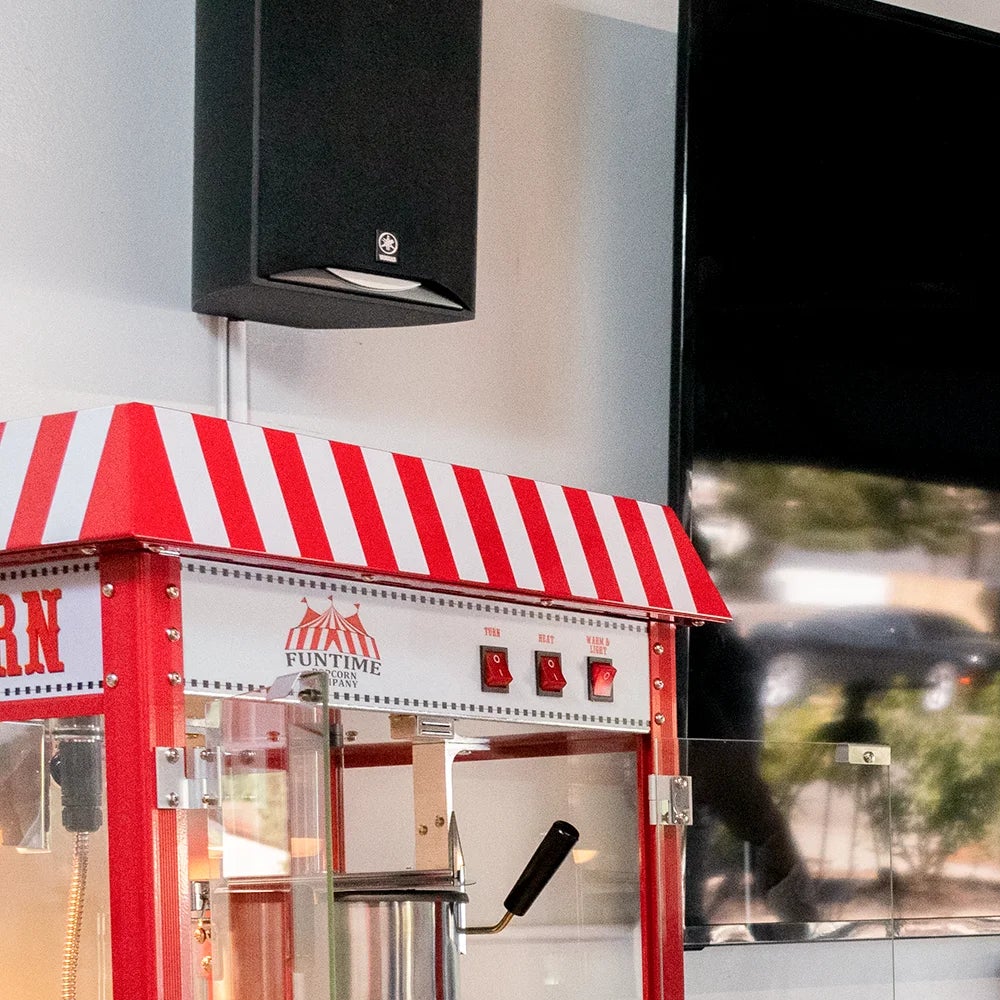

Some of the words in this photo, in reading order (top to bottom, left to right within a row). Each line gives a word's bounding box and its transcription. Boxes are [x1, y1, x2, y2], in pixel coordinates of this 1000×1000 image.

[484, 626, 501, 638] TURN
[538, 633, 555, 645] HEAT
[586, 635, 605, 646] WARM
[589, 644, 608, 656] LIGHT
[285, 652, 382, 676] FUNTIME
[312, 668, 357, 680] CORN
[328, 678, 358, 689] PANY
